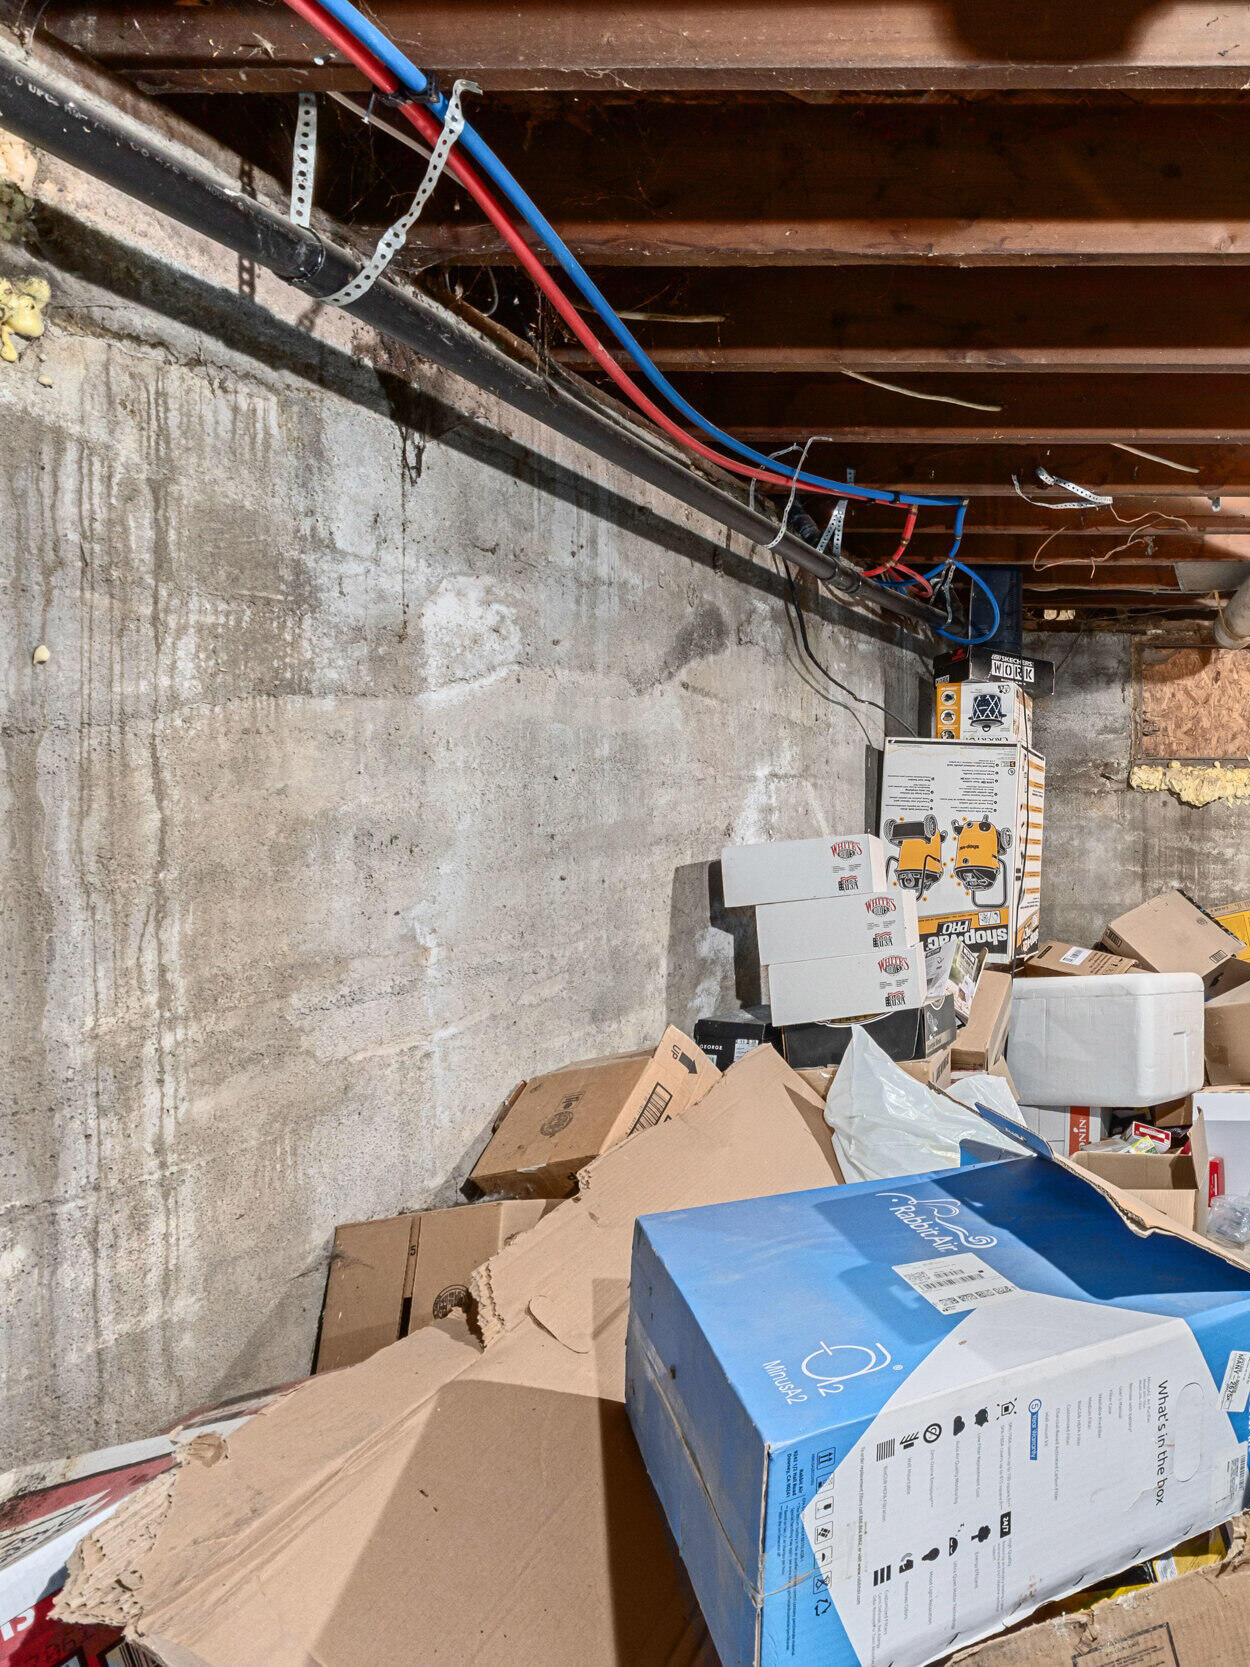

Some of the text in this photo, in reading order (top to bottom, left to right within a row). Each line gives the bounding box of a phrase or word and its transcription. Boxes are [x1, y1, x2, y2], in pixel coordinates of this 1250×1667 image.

[991, 660, 1035, 683] WORK
[1001, 655, 1033, 667] SKECHERS
[942, 920, 968, 934] PRO
[672, 1044, 683, 1062] UP
[889, 1204, 959, 1254] Rabbit Air
[1233, 1353, 1244, 1375] MANY
[762, 1359, 808, 1405] MinusA2
[1031, 1413, 1039, 1427] Year
[1030, 1428, 1039, 1458] Warranty
[1155, 1379, 1169, 1507] What's in the box
